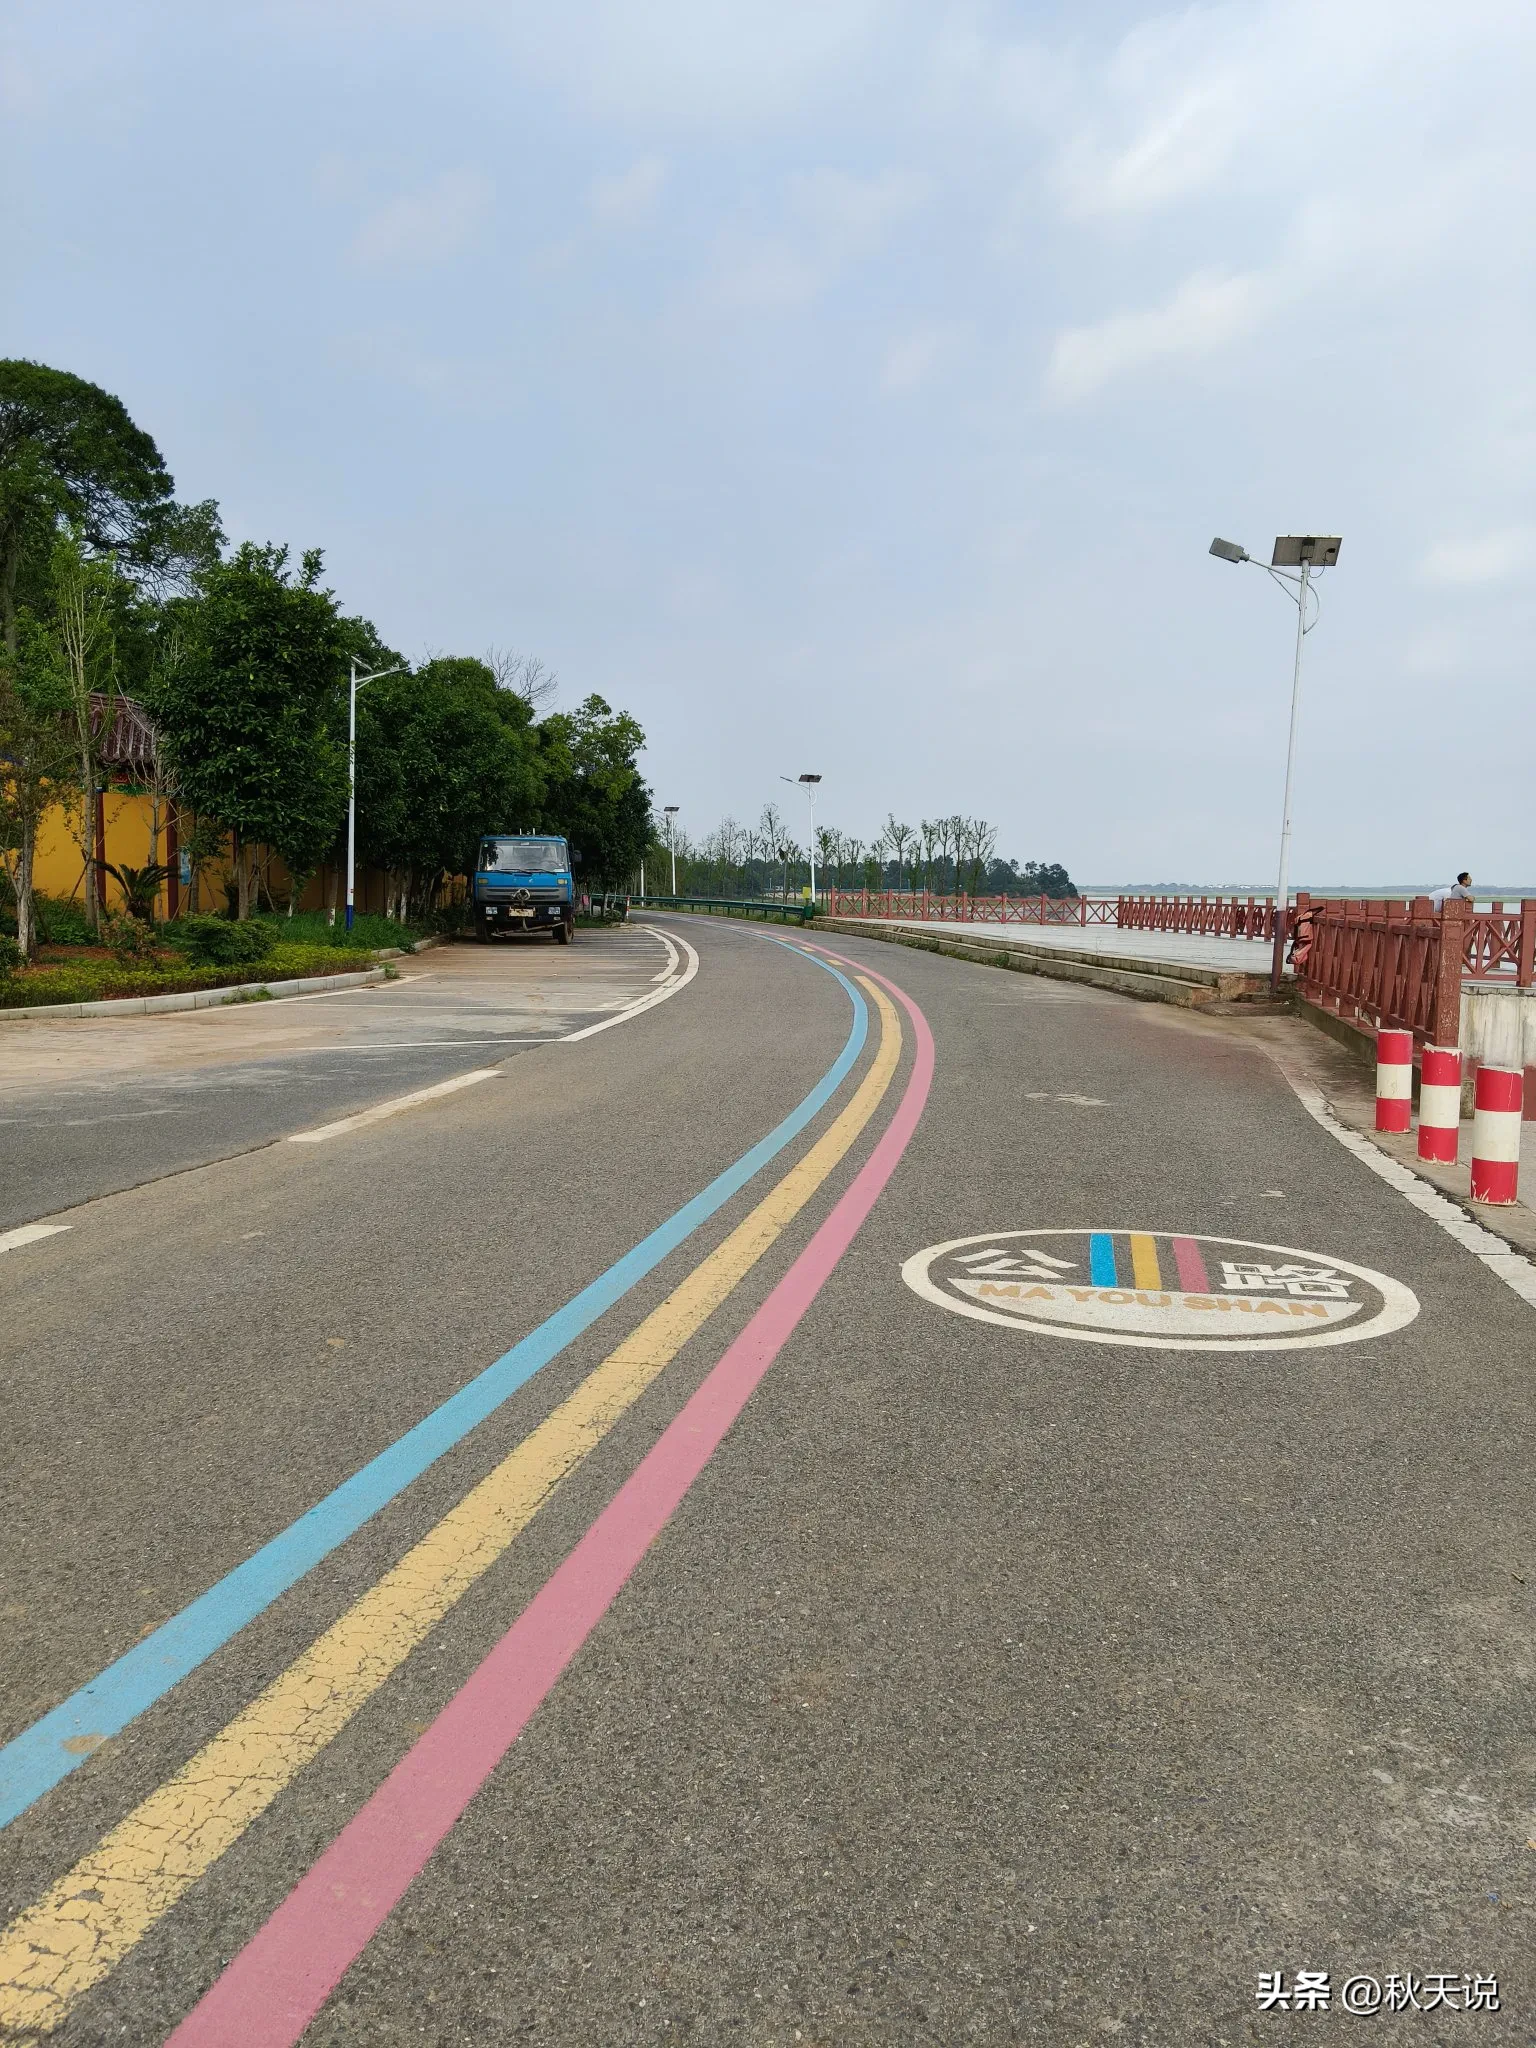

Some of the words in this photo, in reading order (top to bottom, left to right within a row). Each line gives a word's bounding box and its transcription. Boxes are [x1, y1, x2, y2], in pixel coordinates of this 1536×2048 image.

[976, 1283, 1059, 1302] MA
[1062, 1286, 1173, 1309] YOU
[1183, 1294, 1330, 1318] SHAN
